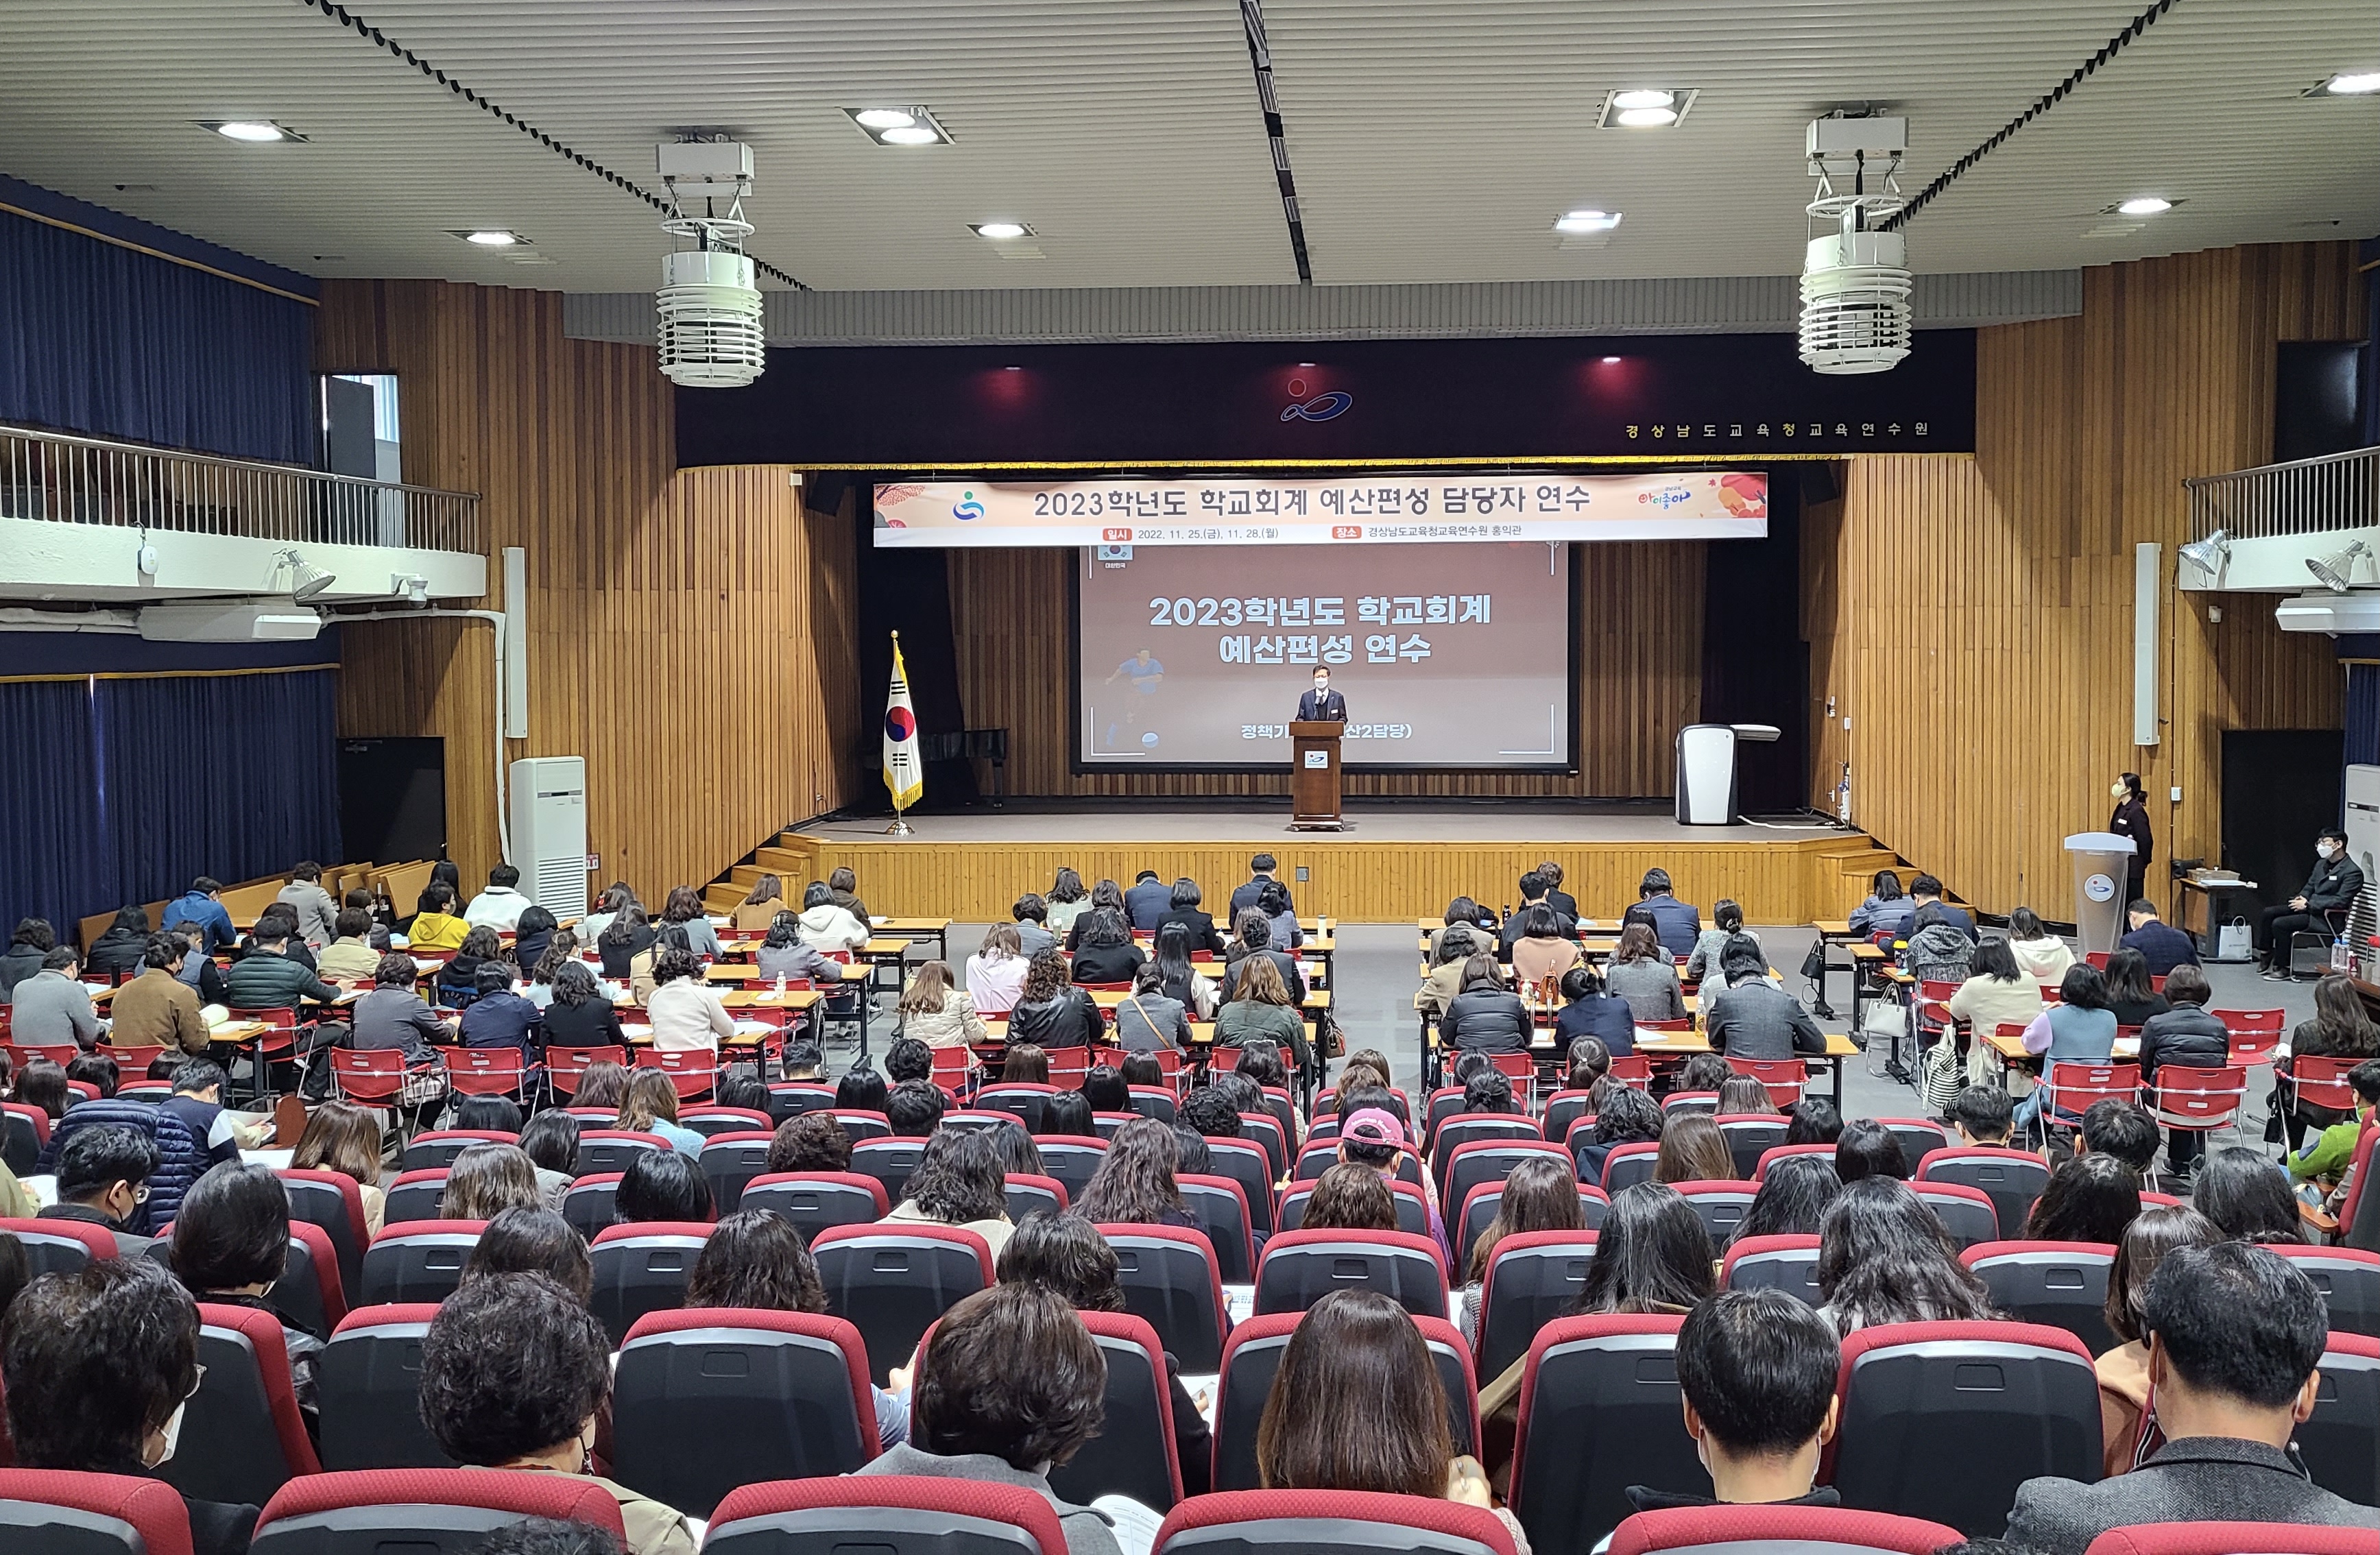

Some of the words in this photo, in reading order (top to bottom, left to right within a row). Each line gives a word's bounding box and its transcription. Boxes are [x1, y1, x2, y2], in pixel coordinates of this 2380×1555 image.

[1626, 422, 1928, 439] 경상남도교육청교육연수원
[1034, 490, 1188, 517] 2023학년도
[1200, 489, 1308, 516] 학교회계
[1320, 488, 1429, 515] 예산편성
[1443, 487, 1526, 514] 담당자
[1536, 485, 1590, 512] 연수
[1638, 491, 1692, 510] 아이좋아
[1107, 529, 1128, 540] 일시
[1138, 529, 1166, 540] 2022.
[1170, 530, 1184, 540] 11.
[1227, 529, 1242, 539] 11.
[1246, 527, 1279, 540] 28.(월)
[1336, 527, 1358, 539] 장소
[1368, 525, 1488, 538] 경상남도교육청교육연수원
[1491, 525, 1522, 536] 홍익관
[1149, 596, 1346, 627] 2023학년도
[1357, 594, 1491, 626] 학교회계
[1218, 634, 1353, 664] 예산편성
[1365, 634, 1432, 664] 연수
[1241, 724, 1290, 740] 정책기
[1345, 723, 1413, 740] 산2담당)
